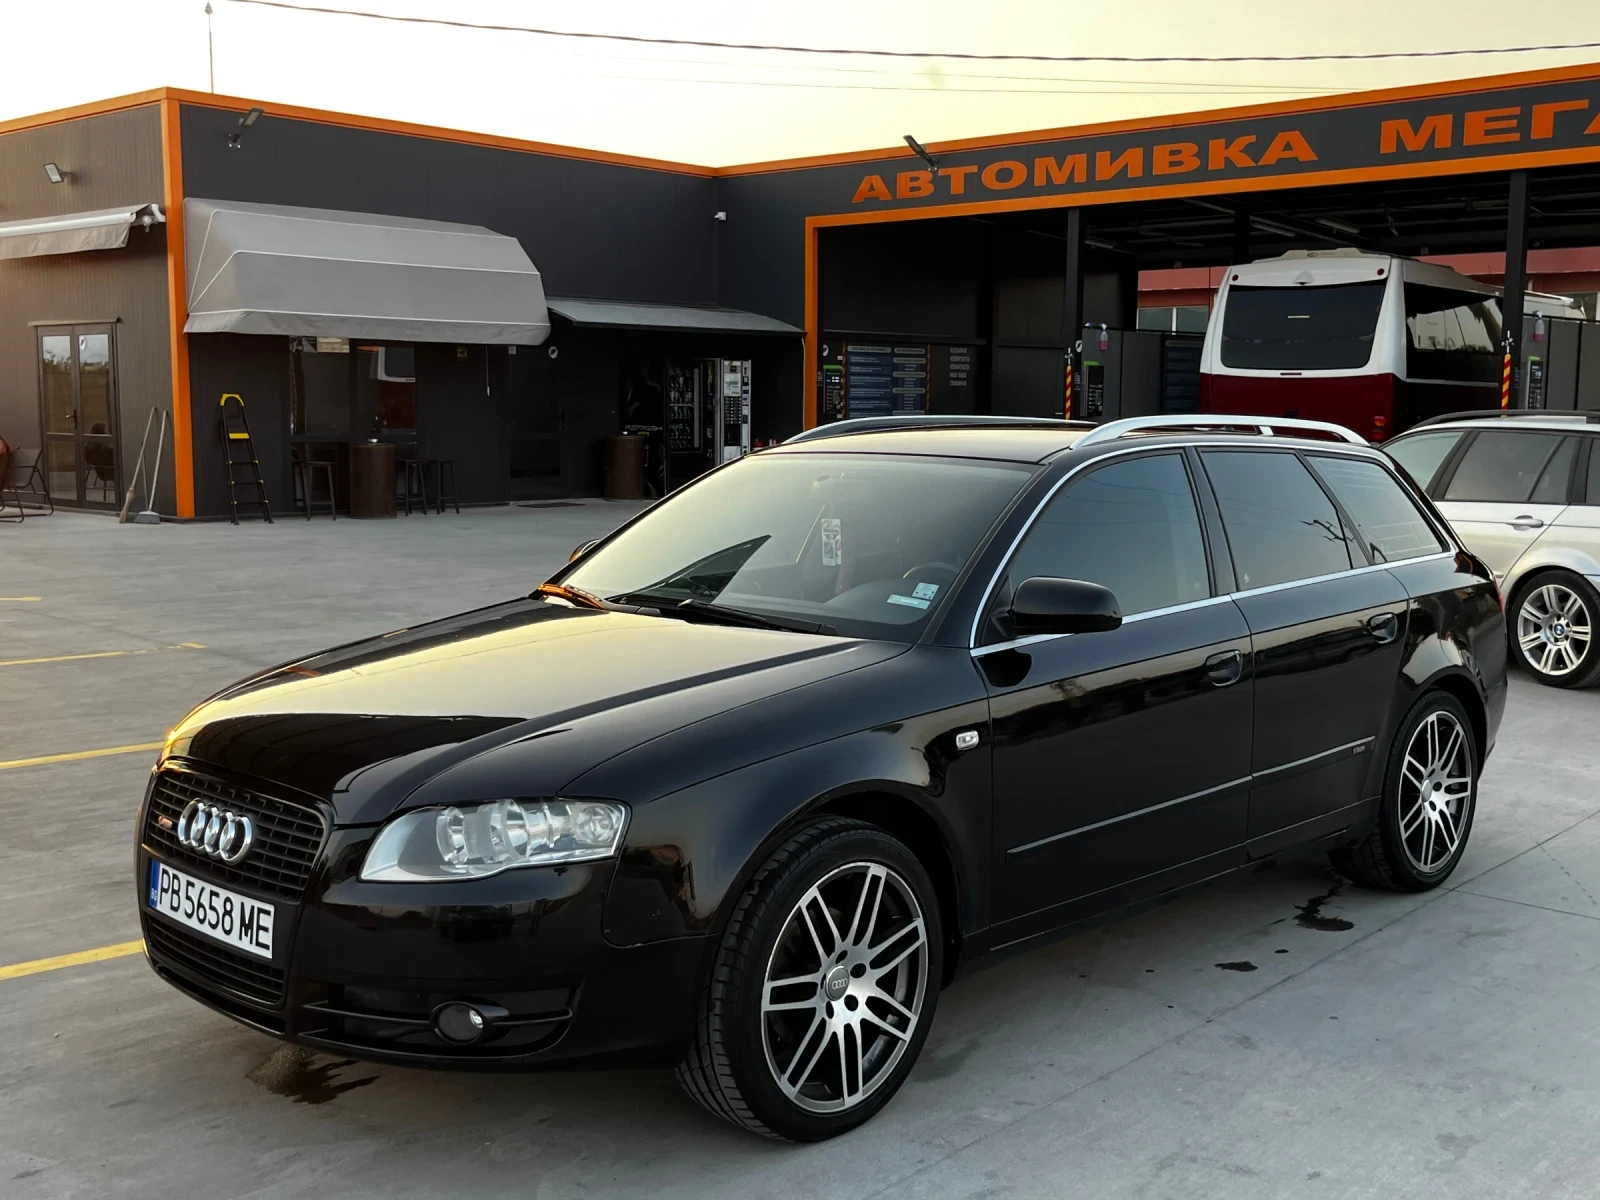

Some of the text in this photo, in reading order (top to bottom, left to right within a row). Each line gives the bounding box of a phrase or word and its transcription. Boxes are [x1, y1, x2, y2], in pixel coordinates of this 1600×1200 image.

[851, 99, 1600, 203] АВТОМИВКА МЕГ
[159, 867, 272, 951] PB 5658 ME
